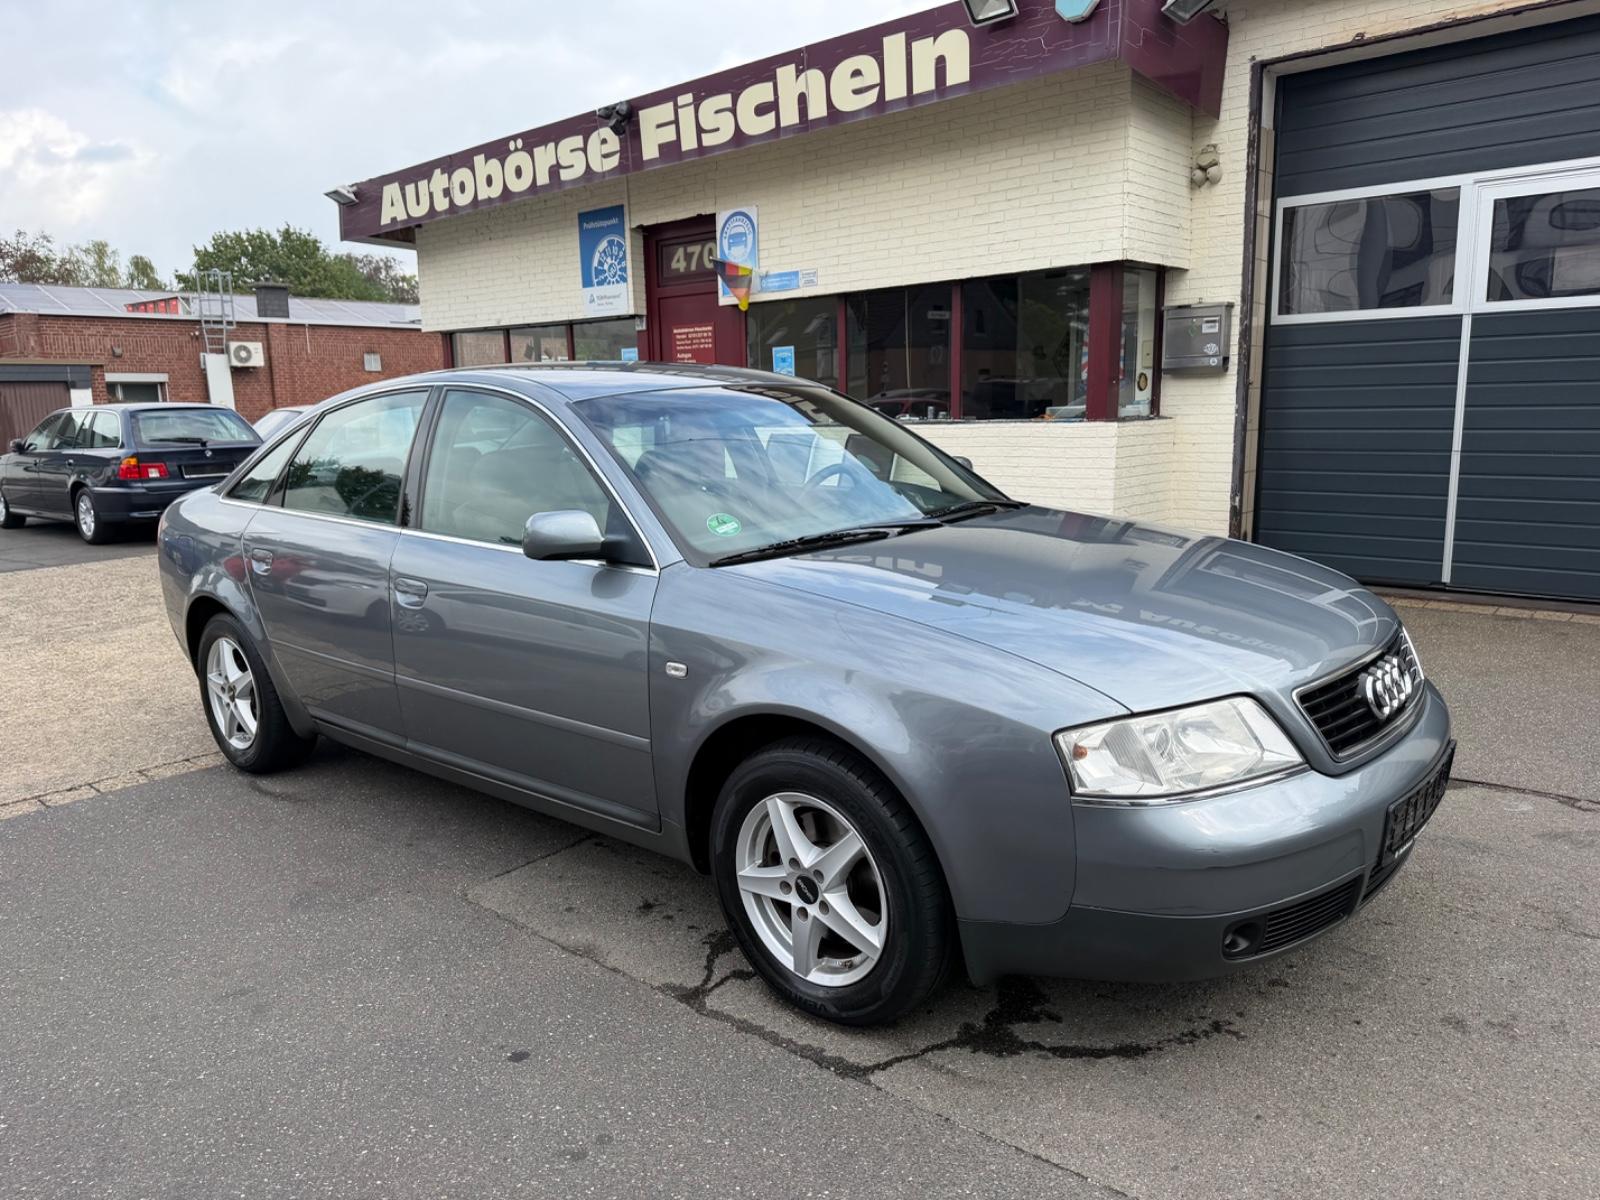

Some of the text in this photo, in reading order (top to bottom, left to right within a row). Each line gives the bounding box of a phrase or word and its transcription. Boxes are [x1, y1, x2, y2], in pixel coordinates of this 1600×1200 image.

[380, 28, 970, 226] Autobörse Fischeln
[670, 241, 716, 273] 470
